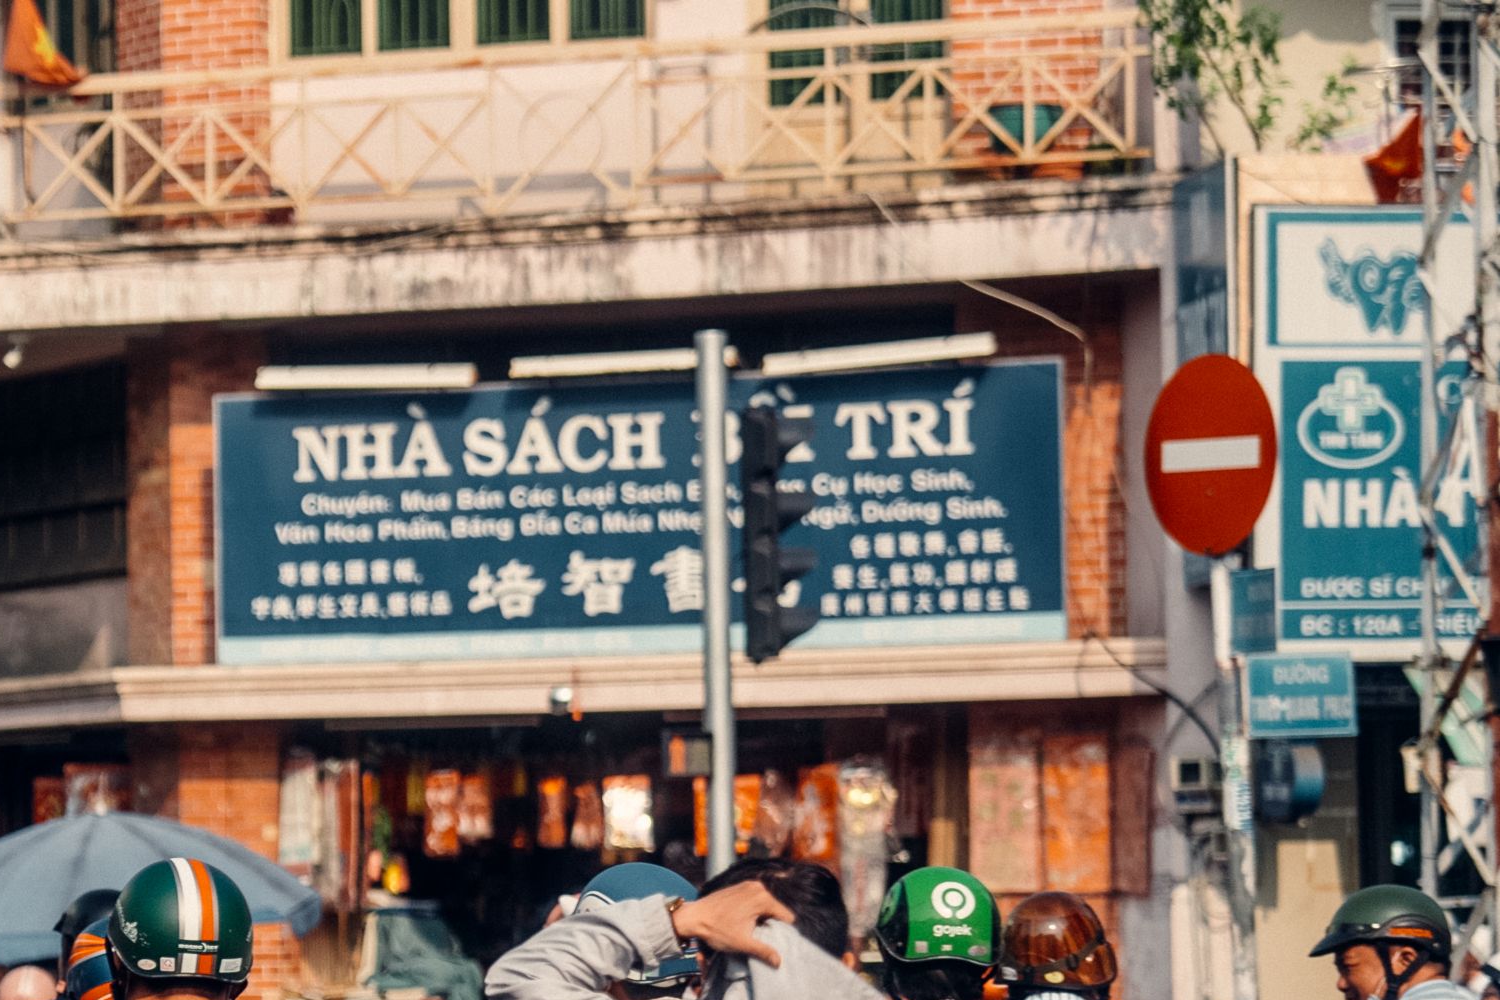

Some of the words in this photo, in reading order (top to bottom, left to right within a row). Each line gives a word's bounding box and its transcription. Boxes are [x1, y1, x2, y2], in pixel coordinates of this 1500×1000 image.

[292, 402, 452, 483] NHÀ
[463, 396, 666, 477] SÁCH
[834, 378, 976, 461] TRÍ
[400, 489, 451, 512] Mua
[1303, 467, 1422, 528] NHÀ
[564, 510, 599, 535] Ca
[932, 924, 973, 937] gojek
